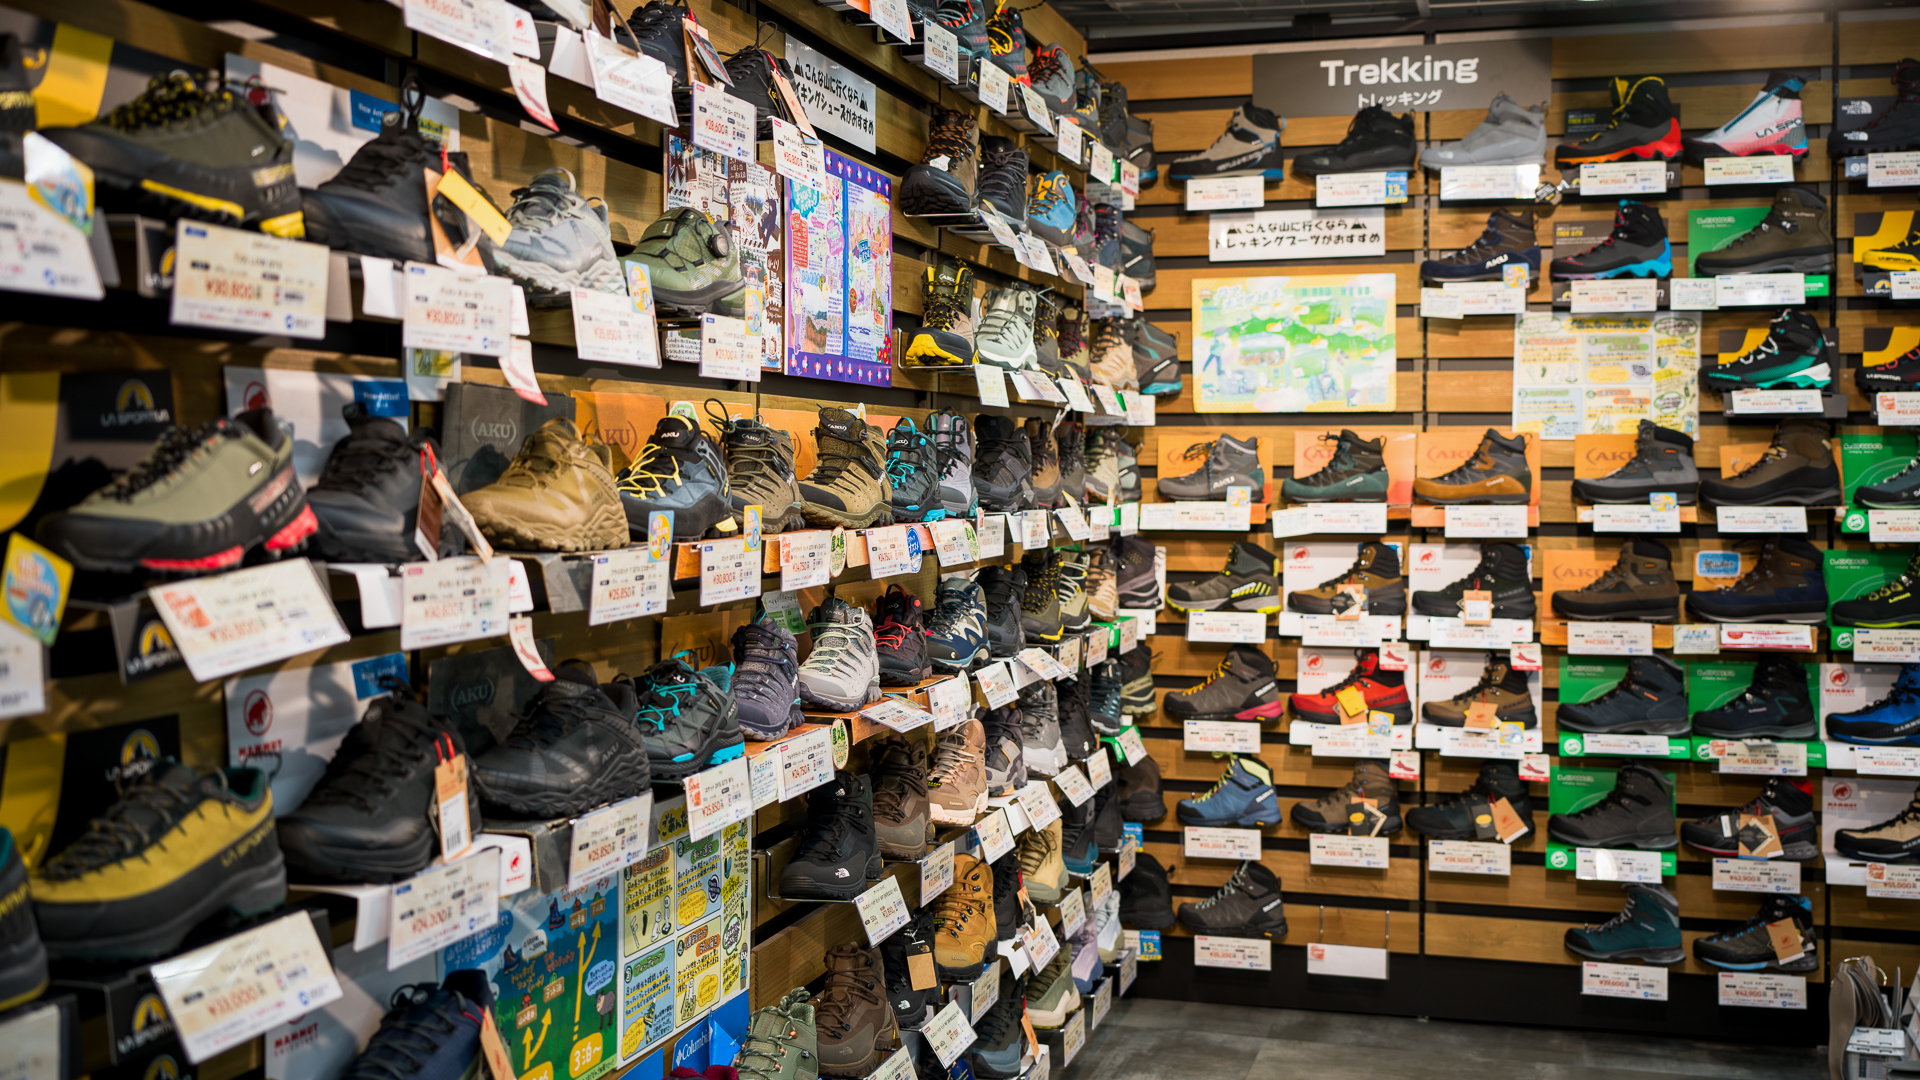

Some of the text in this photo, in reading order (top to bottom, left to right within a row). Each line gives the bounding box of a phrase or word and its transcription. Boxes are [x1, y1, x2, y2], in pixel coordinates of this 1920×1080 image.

[1320, 55, 1480, 87] Trekking
[804, 63, 859, 107] こんな山に行くなら
[1357, 89, 1443, 108] トレッキング
[796, 81, 874, 136] イキングシューズがおすすめ
[1755, 128, 1769, 139] LA
[1244, 219, 1348, 235] こんな山に行くなら
[1485, 253, 1509, 269] AKU
[205, 280, 256, 299] ¥30,800
[426, 308, 462, 326] ¥30,800
[1874, 373, 1901, 381] SPORTIVA
[100, 408, 170, 425] LA SPORTIVA
[476, 422, 513, 438] AKU
[659, 431, 680, 439] AKU
[1212, 475, 1236, 490] AKU
[713, 572, 733, 585] ¥30,800
[608, 586, 632, 601] ¥25,850
[457, 685, 488, 704] AKU
[726, 700, 737, 719] AKU
[602, 741, 620, 764] AKU
[702, 800, 721, 818] ¥25,850
[587, 842, 611, 862] ¥25,850
[634, 947, 665, 974] フィッティング
[683, 1031, 712, 1061] Columbi
